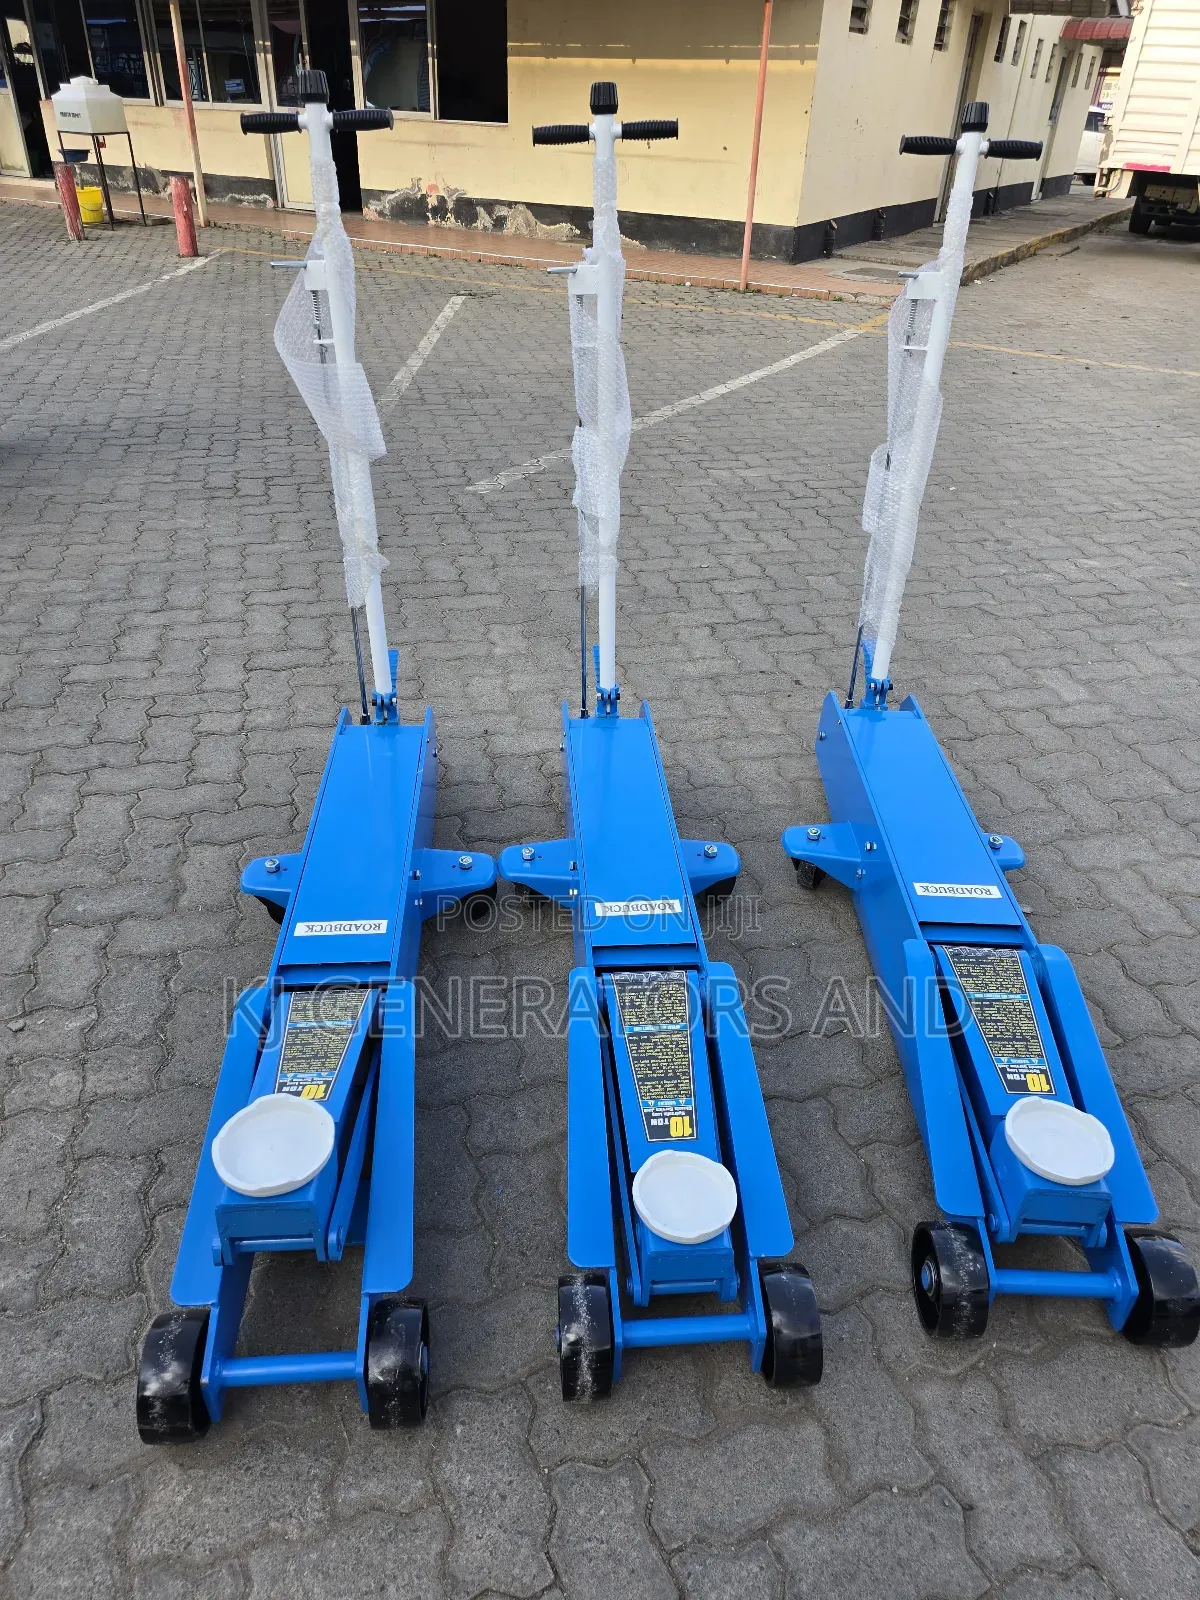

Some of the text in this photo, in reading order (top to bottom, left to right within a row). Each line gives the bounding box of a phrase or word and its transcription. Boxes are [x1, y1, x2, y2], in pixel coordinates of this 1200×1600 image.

[919, 885, 993, 896] ROADBUCK
[603, 902, 675, 913] ROADBUCK
[303, 922, 382, 934] ROADBUCK
[1025, 1074, 1050, 1092] 10
[300, 1084, 326, 1100] 10
[651, 1116, 692, 1137] 10 TON
